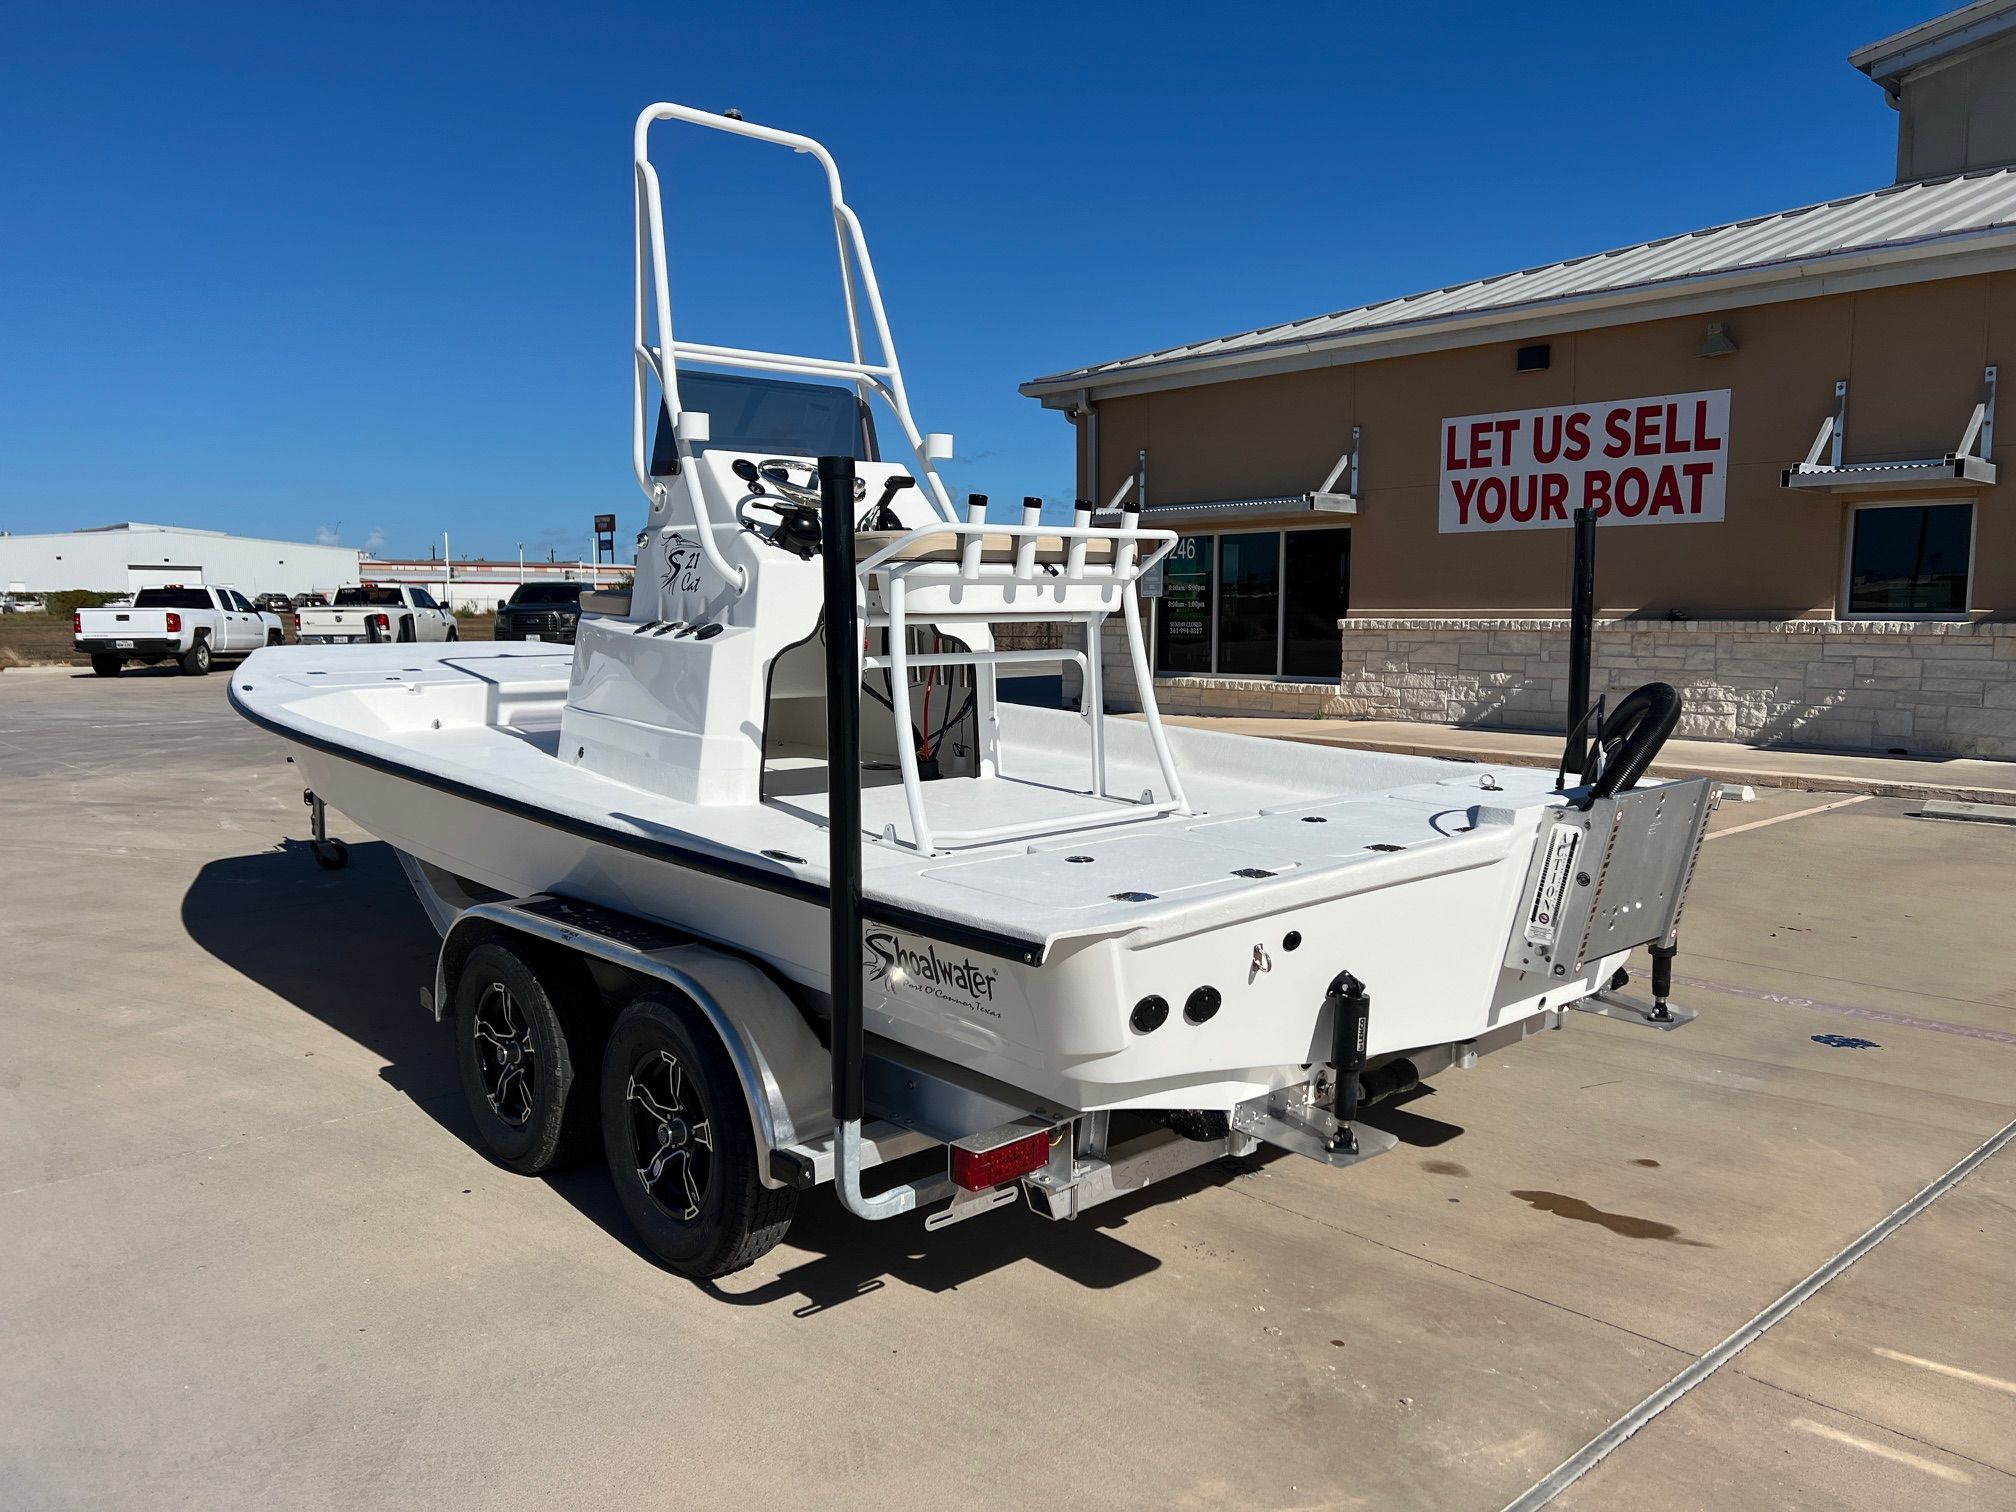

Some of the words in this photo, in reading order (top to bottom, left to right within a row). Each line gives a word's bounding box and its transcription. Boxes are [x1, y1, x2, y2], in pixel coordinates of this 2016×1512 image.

[1446, 418, 1521, 471] LET
[1533, 411, 1592, 464] US
[1603, 400, 1722, 459] SELL
[1451, 472, 1569, 525] YOUR
[1584, 462, 1714, 518] BOAT
[681, 571, 702, 593] Cat
[685, 552, 701, 570] 21
[1541, 831, 1568, 911] ACTION
[865, 933, 997, 1001] Shoalwater
[975, 1001, 1002, 1019] Texas
[1358, 1018, 1366, 1045] LENCO
